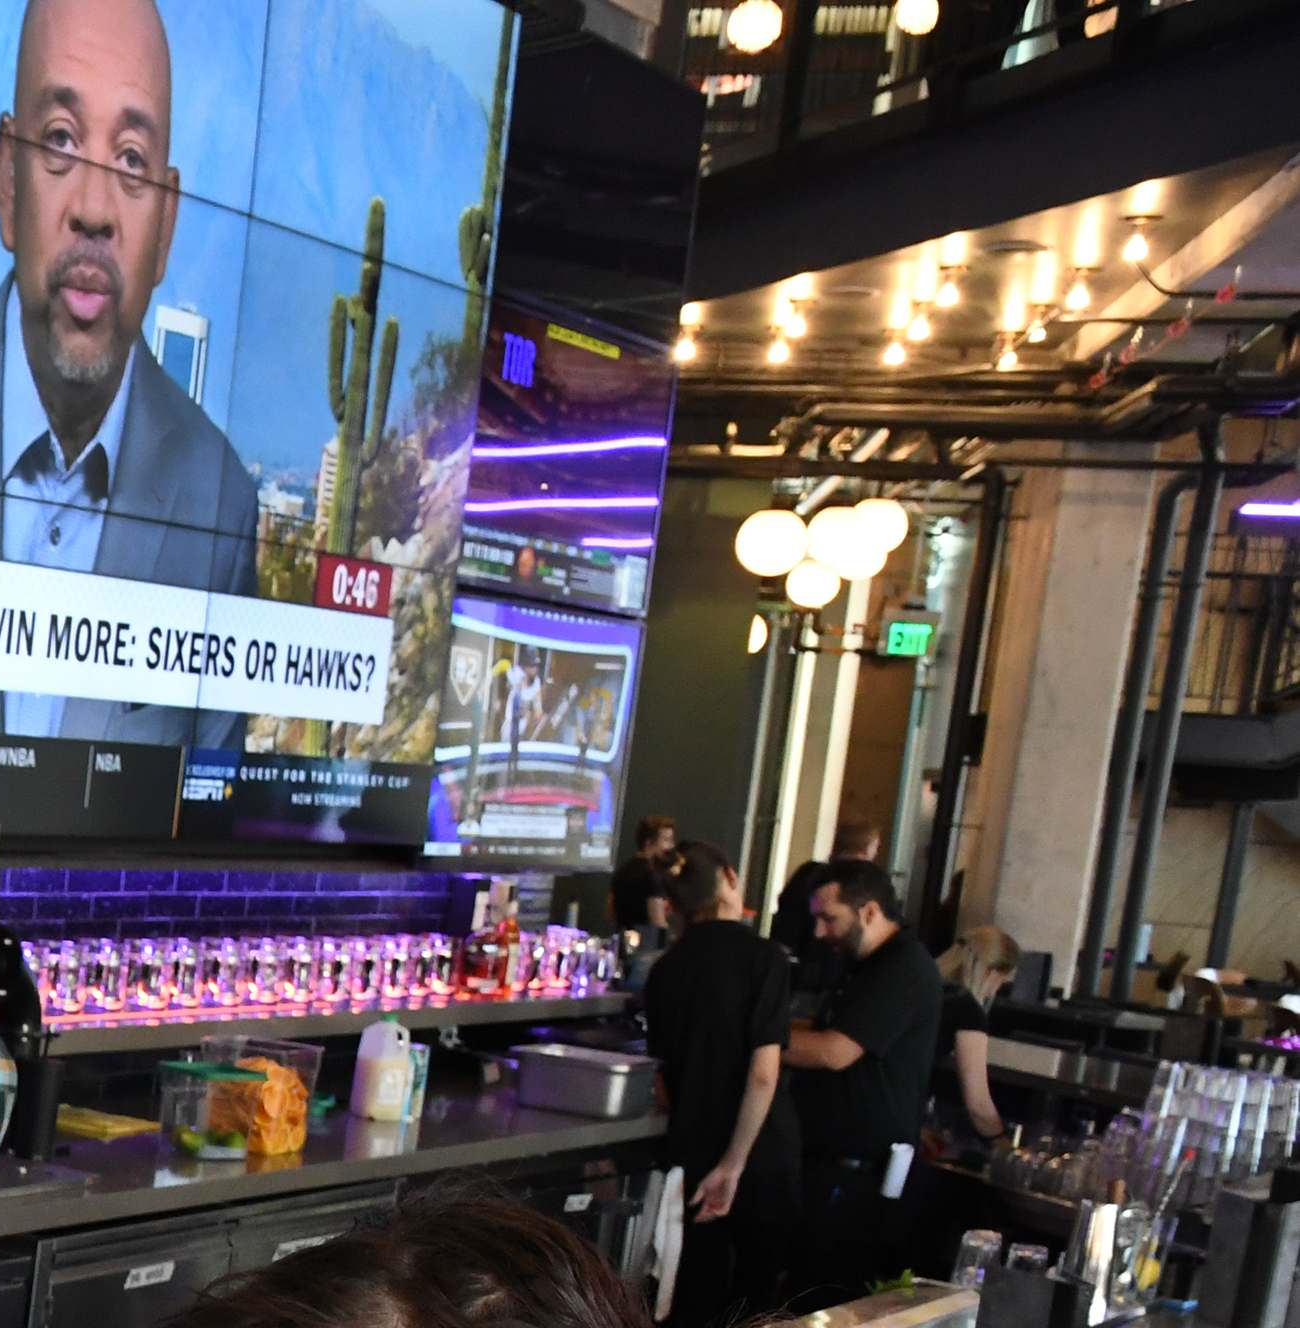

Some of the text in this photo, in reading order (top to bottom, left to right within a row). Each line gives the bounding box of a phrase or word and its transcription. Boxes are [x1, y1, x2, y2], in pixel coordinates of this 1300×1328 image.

[331, 564, 381, 610] 0:46
[46, 614, 137, 668] MORE:
[145, 626, 236, 679] SIXERS
[244, 638, 276, 684] OR
[285, 644, 376, 695] HAWKS?
[94, 752, 123, 773] NBA
[239, 766, 279, 783] QUEST
[283, 767, 306, 783] FOR
[310, 770, 332, 785] THE
[336, 771, 385, 788] STANLEY
